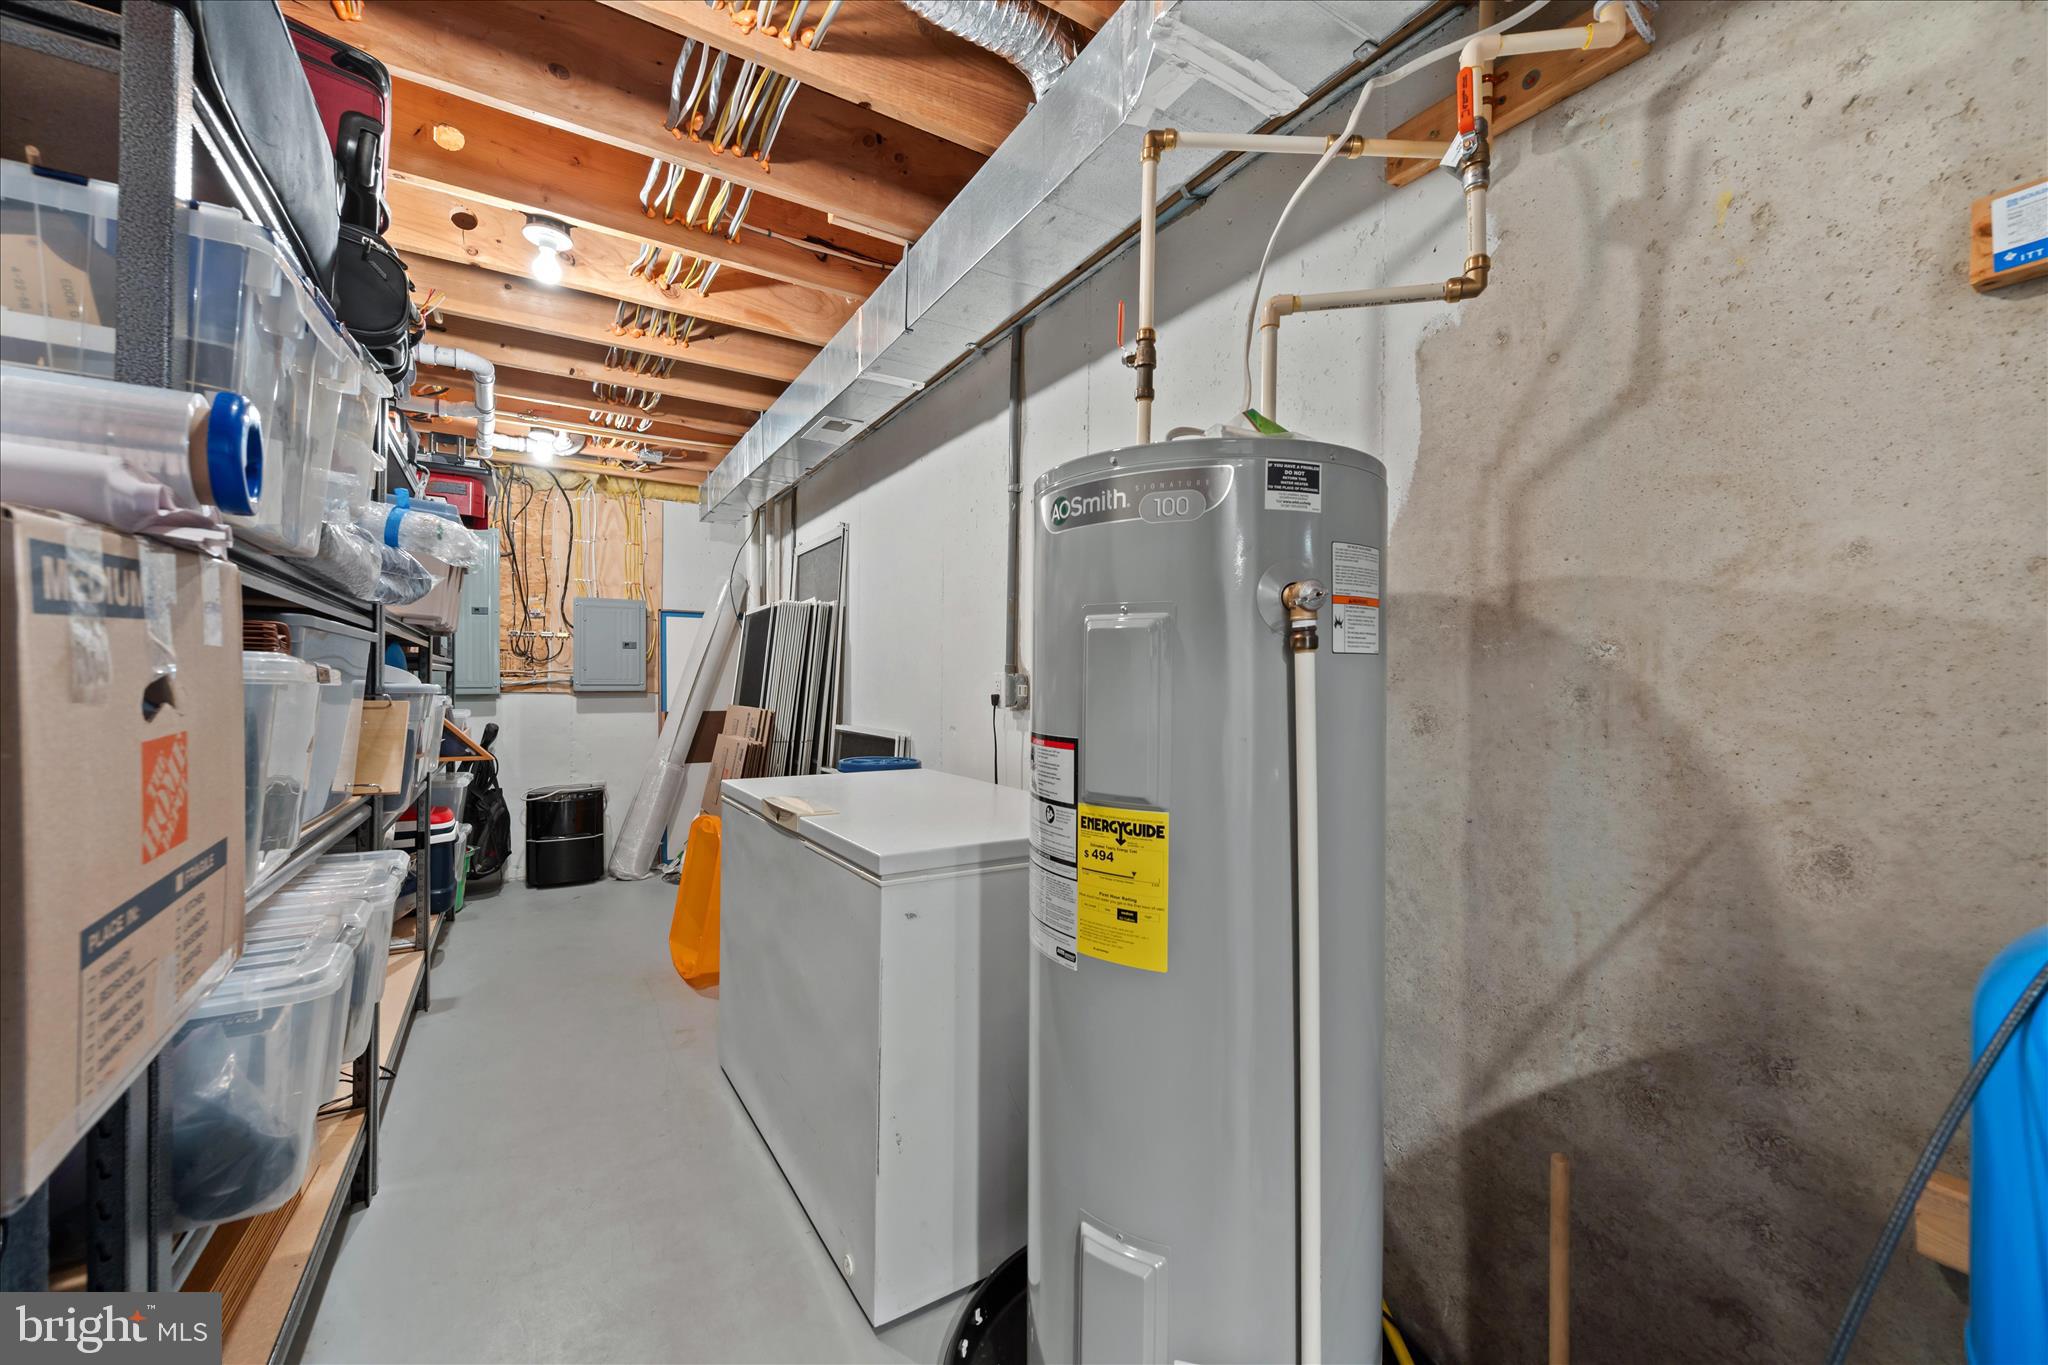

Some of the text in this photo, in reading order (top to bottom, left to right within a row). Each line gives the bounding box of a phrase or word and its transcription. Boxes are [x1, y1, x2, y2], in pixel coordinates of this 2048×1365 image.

[2020, 248, 2045, 262] ITT
[1135, 480, 1210, 492] SIGNATURE
[1153, 496, 1190, 518] 100
[1092, 849, 1114, 862] 494
